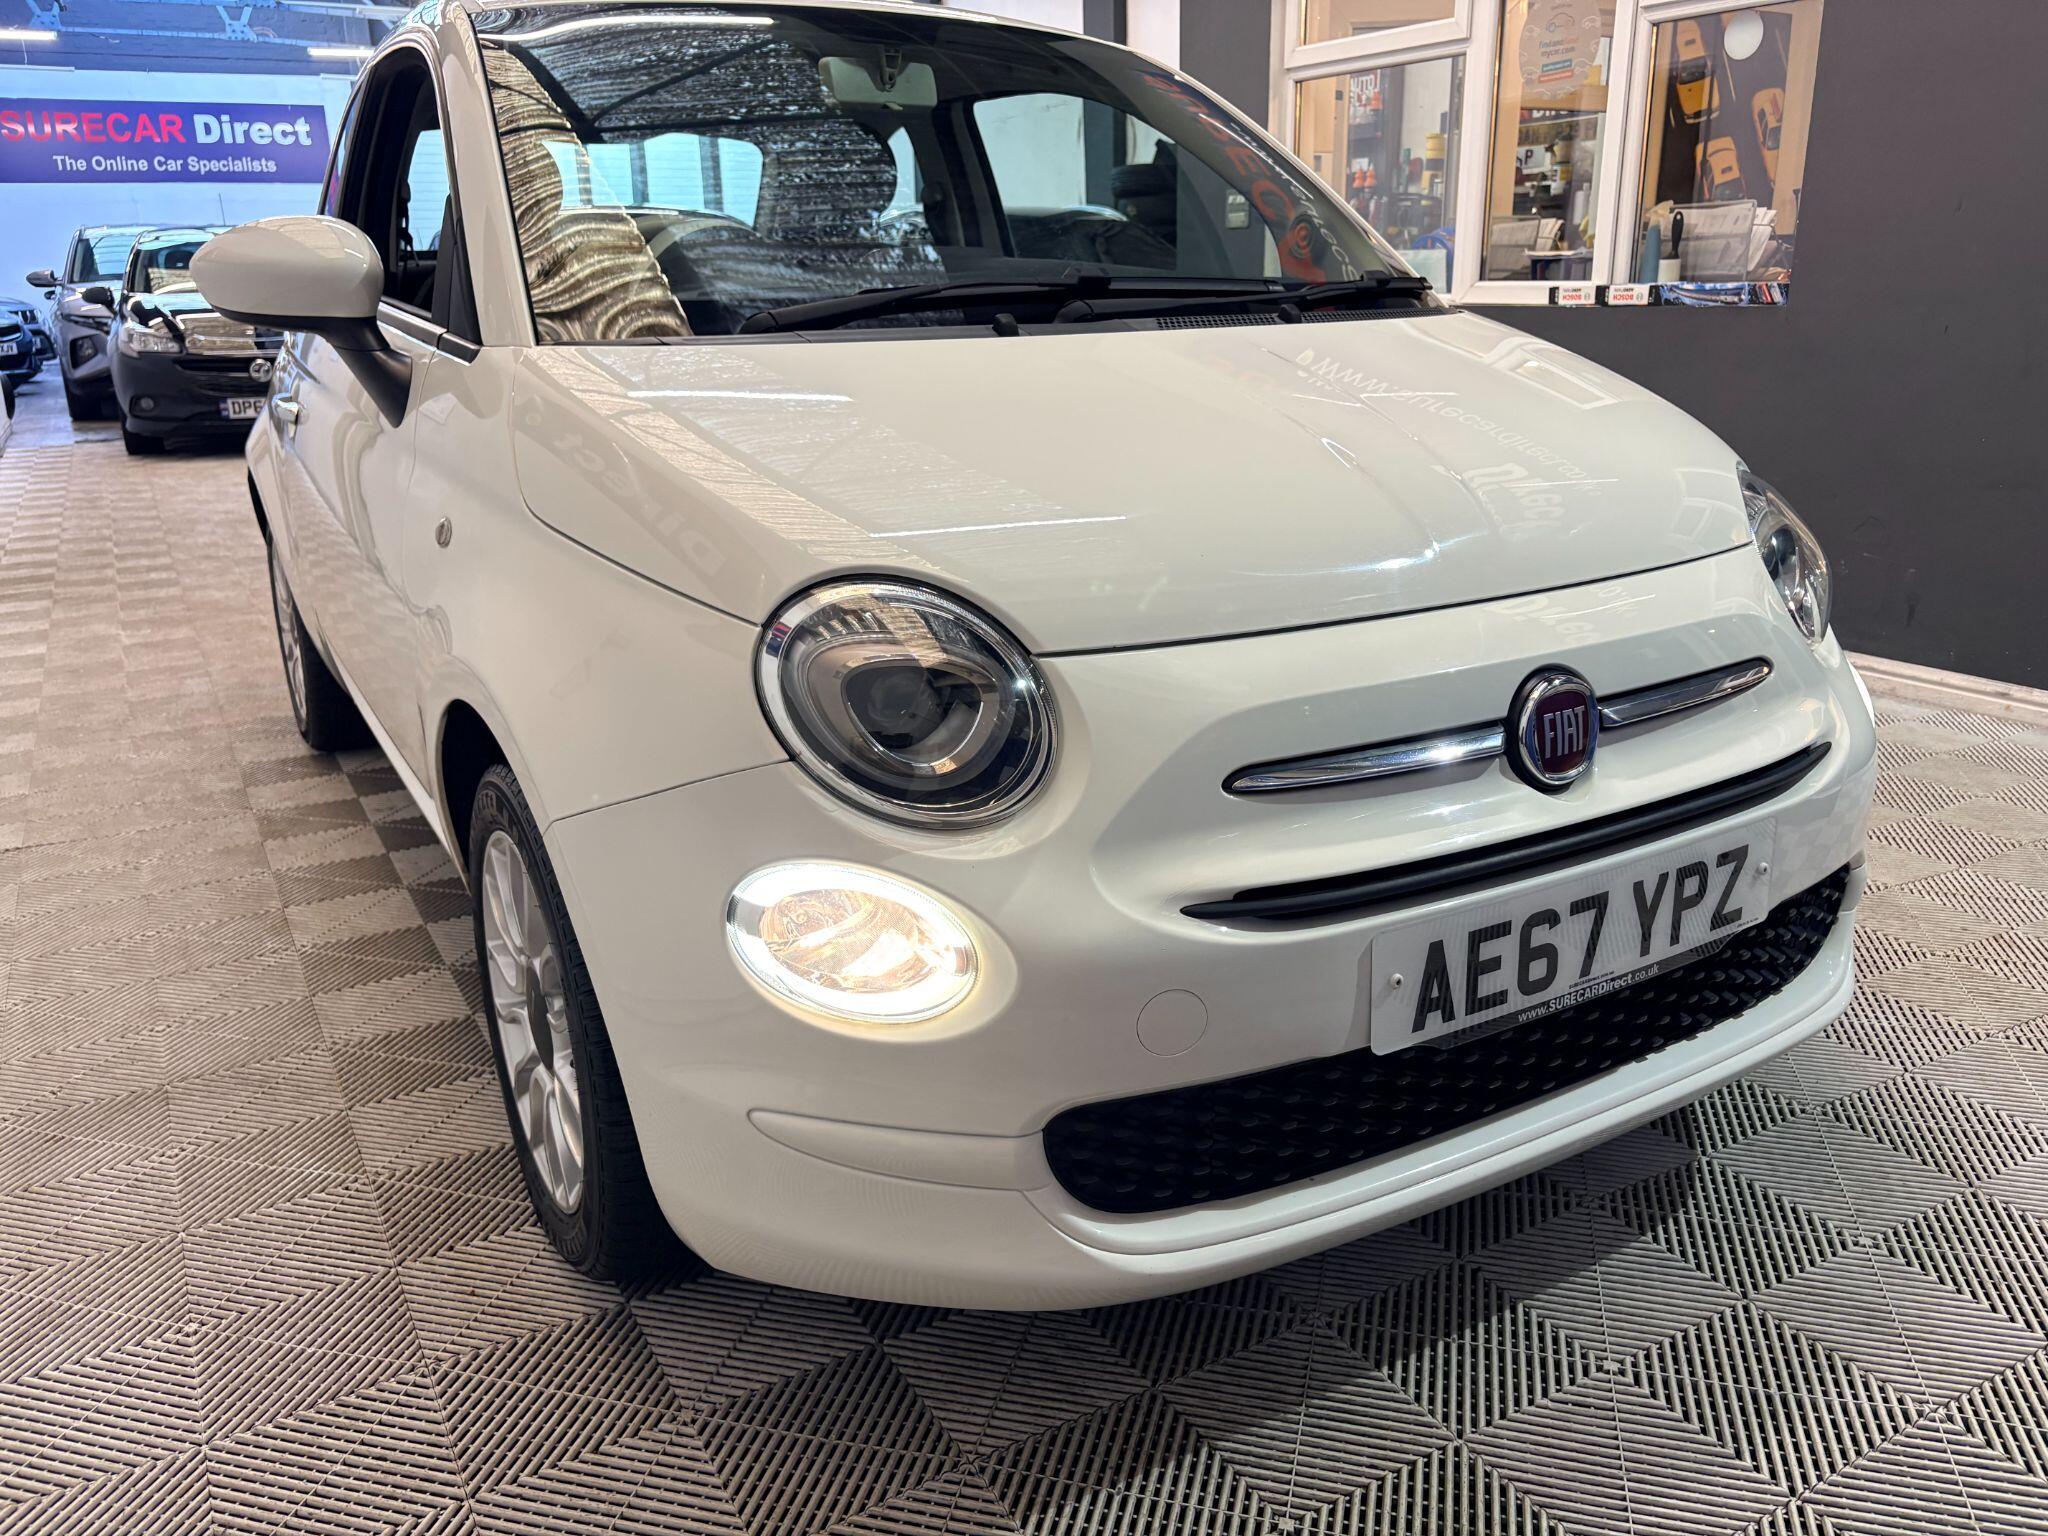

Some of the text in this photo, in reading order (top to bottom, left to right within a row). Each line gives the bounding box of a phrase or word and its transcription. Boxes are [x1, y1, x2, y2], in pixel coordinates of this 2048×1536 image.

[1, 110, 312, 146] SURECAR Direct
[53, 155, 277, 174] The Online Car Specialists
[1543, 705, 1585, 758] FIAT
[1411, 844, 1749, 1033] AE67 YPZ
[1518, 964, 1660, 1022] www.SURECARDirect.co.uk
